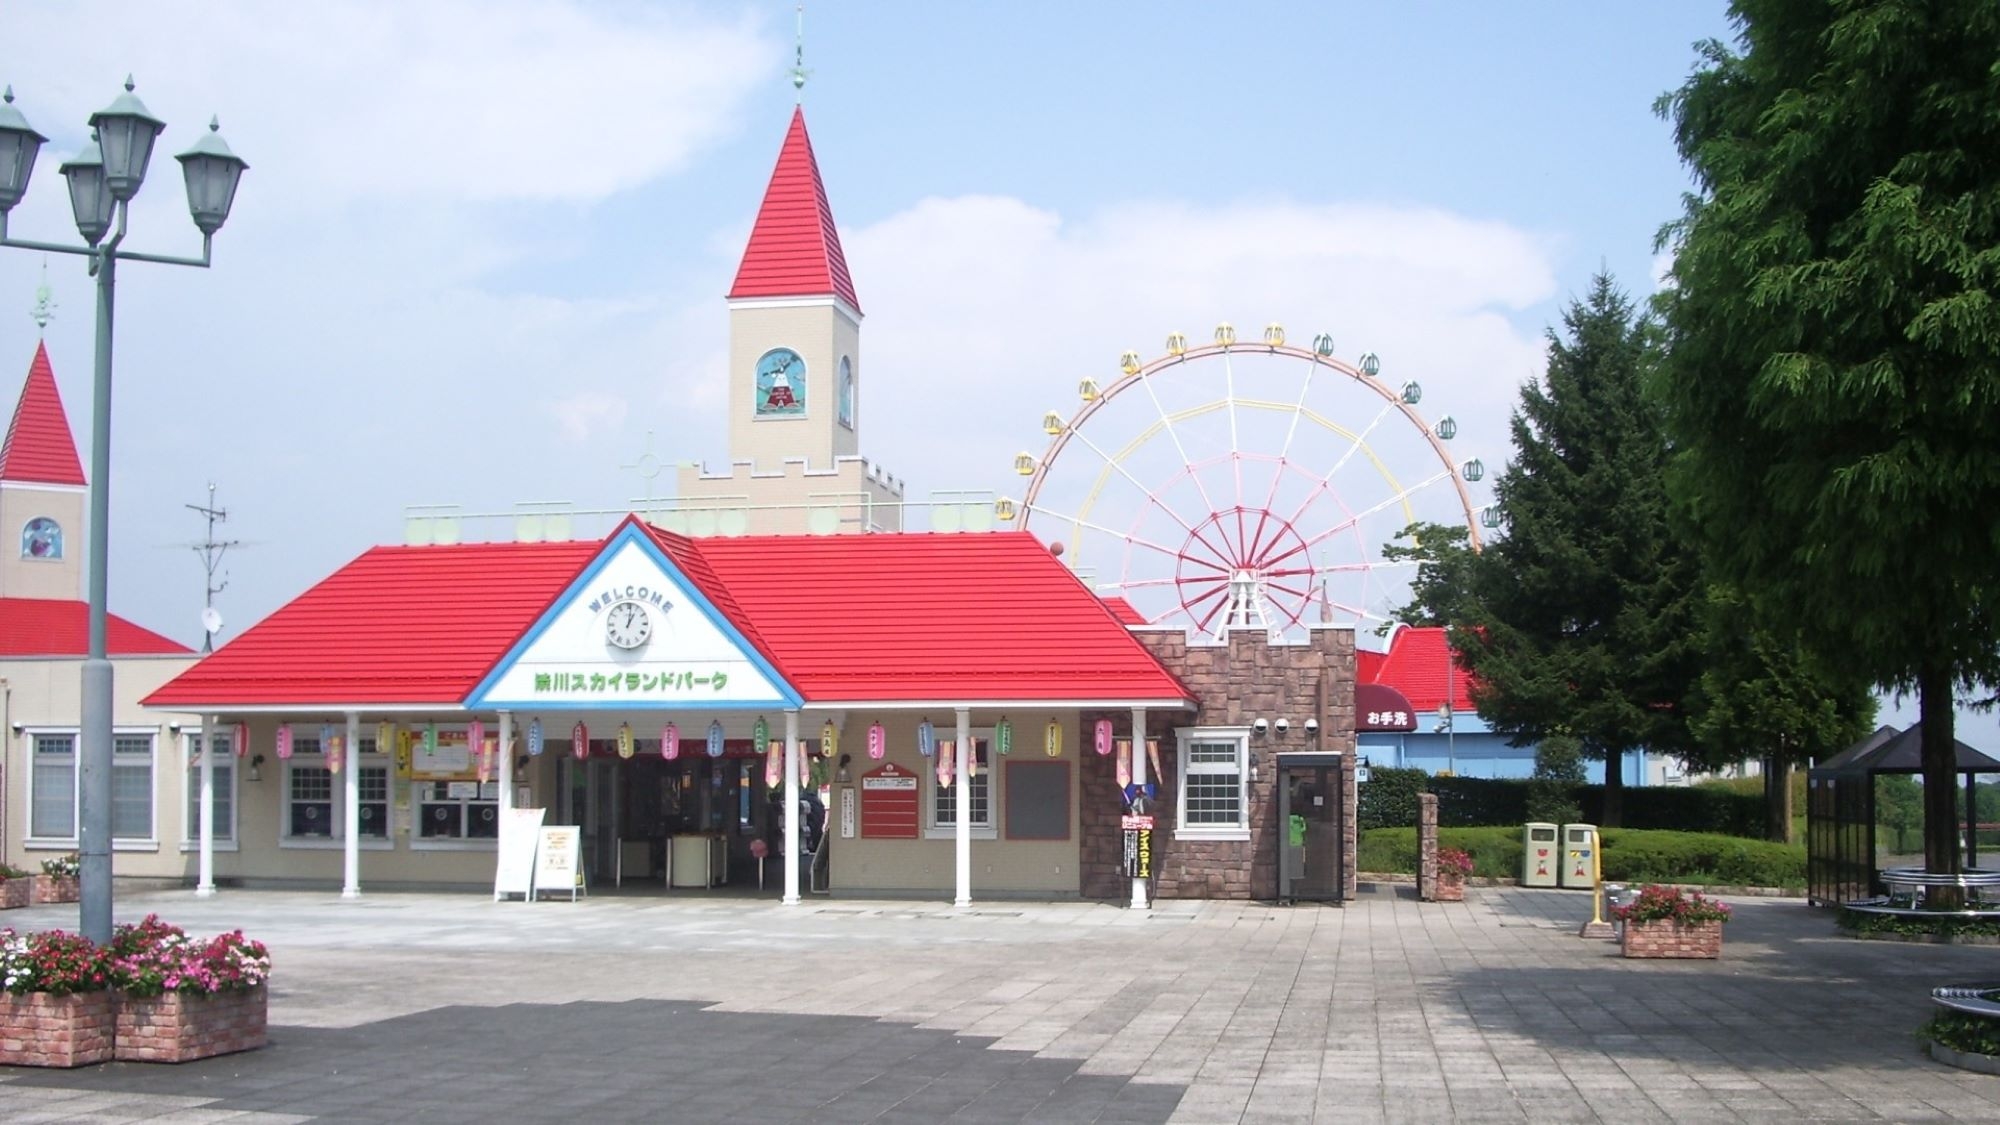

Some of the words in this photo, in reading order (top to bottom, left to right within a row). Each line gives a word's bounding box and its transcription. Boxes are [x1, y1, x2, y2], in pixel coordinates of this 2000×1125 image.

[588, 585, 674, 613] WELCOME
[1367, 711, 1408, 726] お手洗
